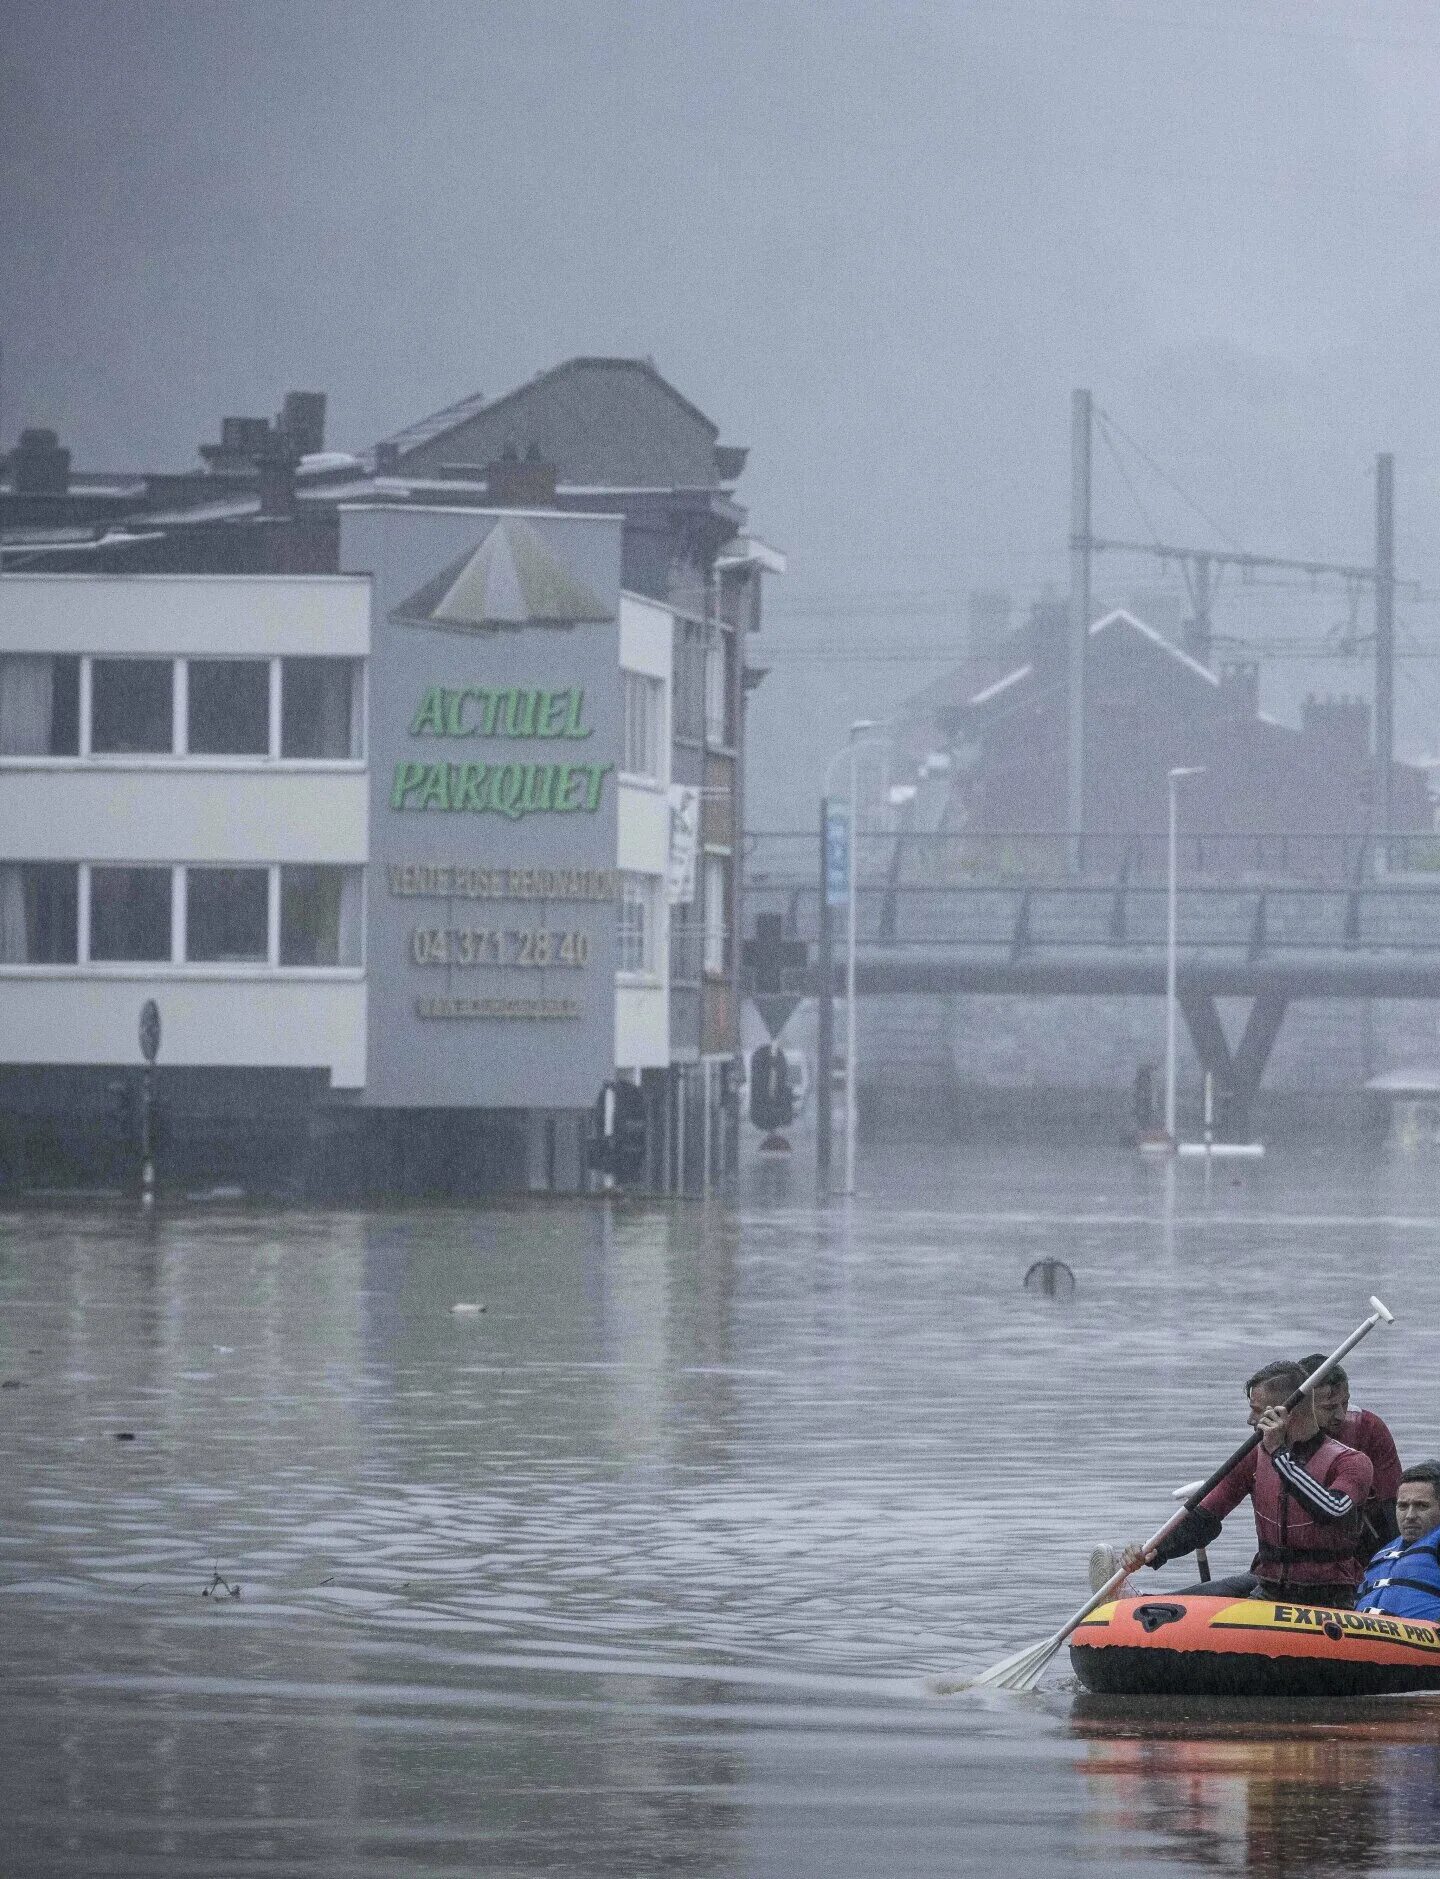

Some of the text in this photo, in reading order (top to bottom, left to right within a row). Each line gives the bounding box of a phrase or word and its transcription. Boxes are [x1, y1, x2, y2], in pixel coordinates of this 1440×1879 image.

[410, 687, 593, 738] ACTUEL
[390, 762, 614, 819] PARQUET
[414, 927, 588, 967] 04 371 28 40
[1274, 1605, 1435, 1644] EXPLORER PRO
